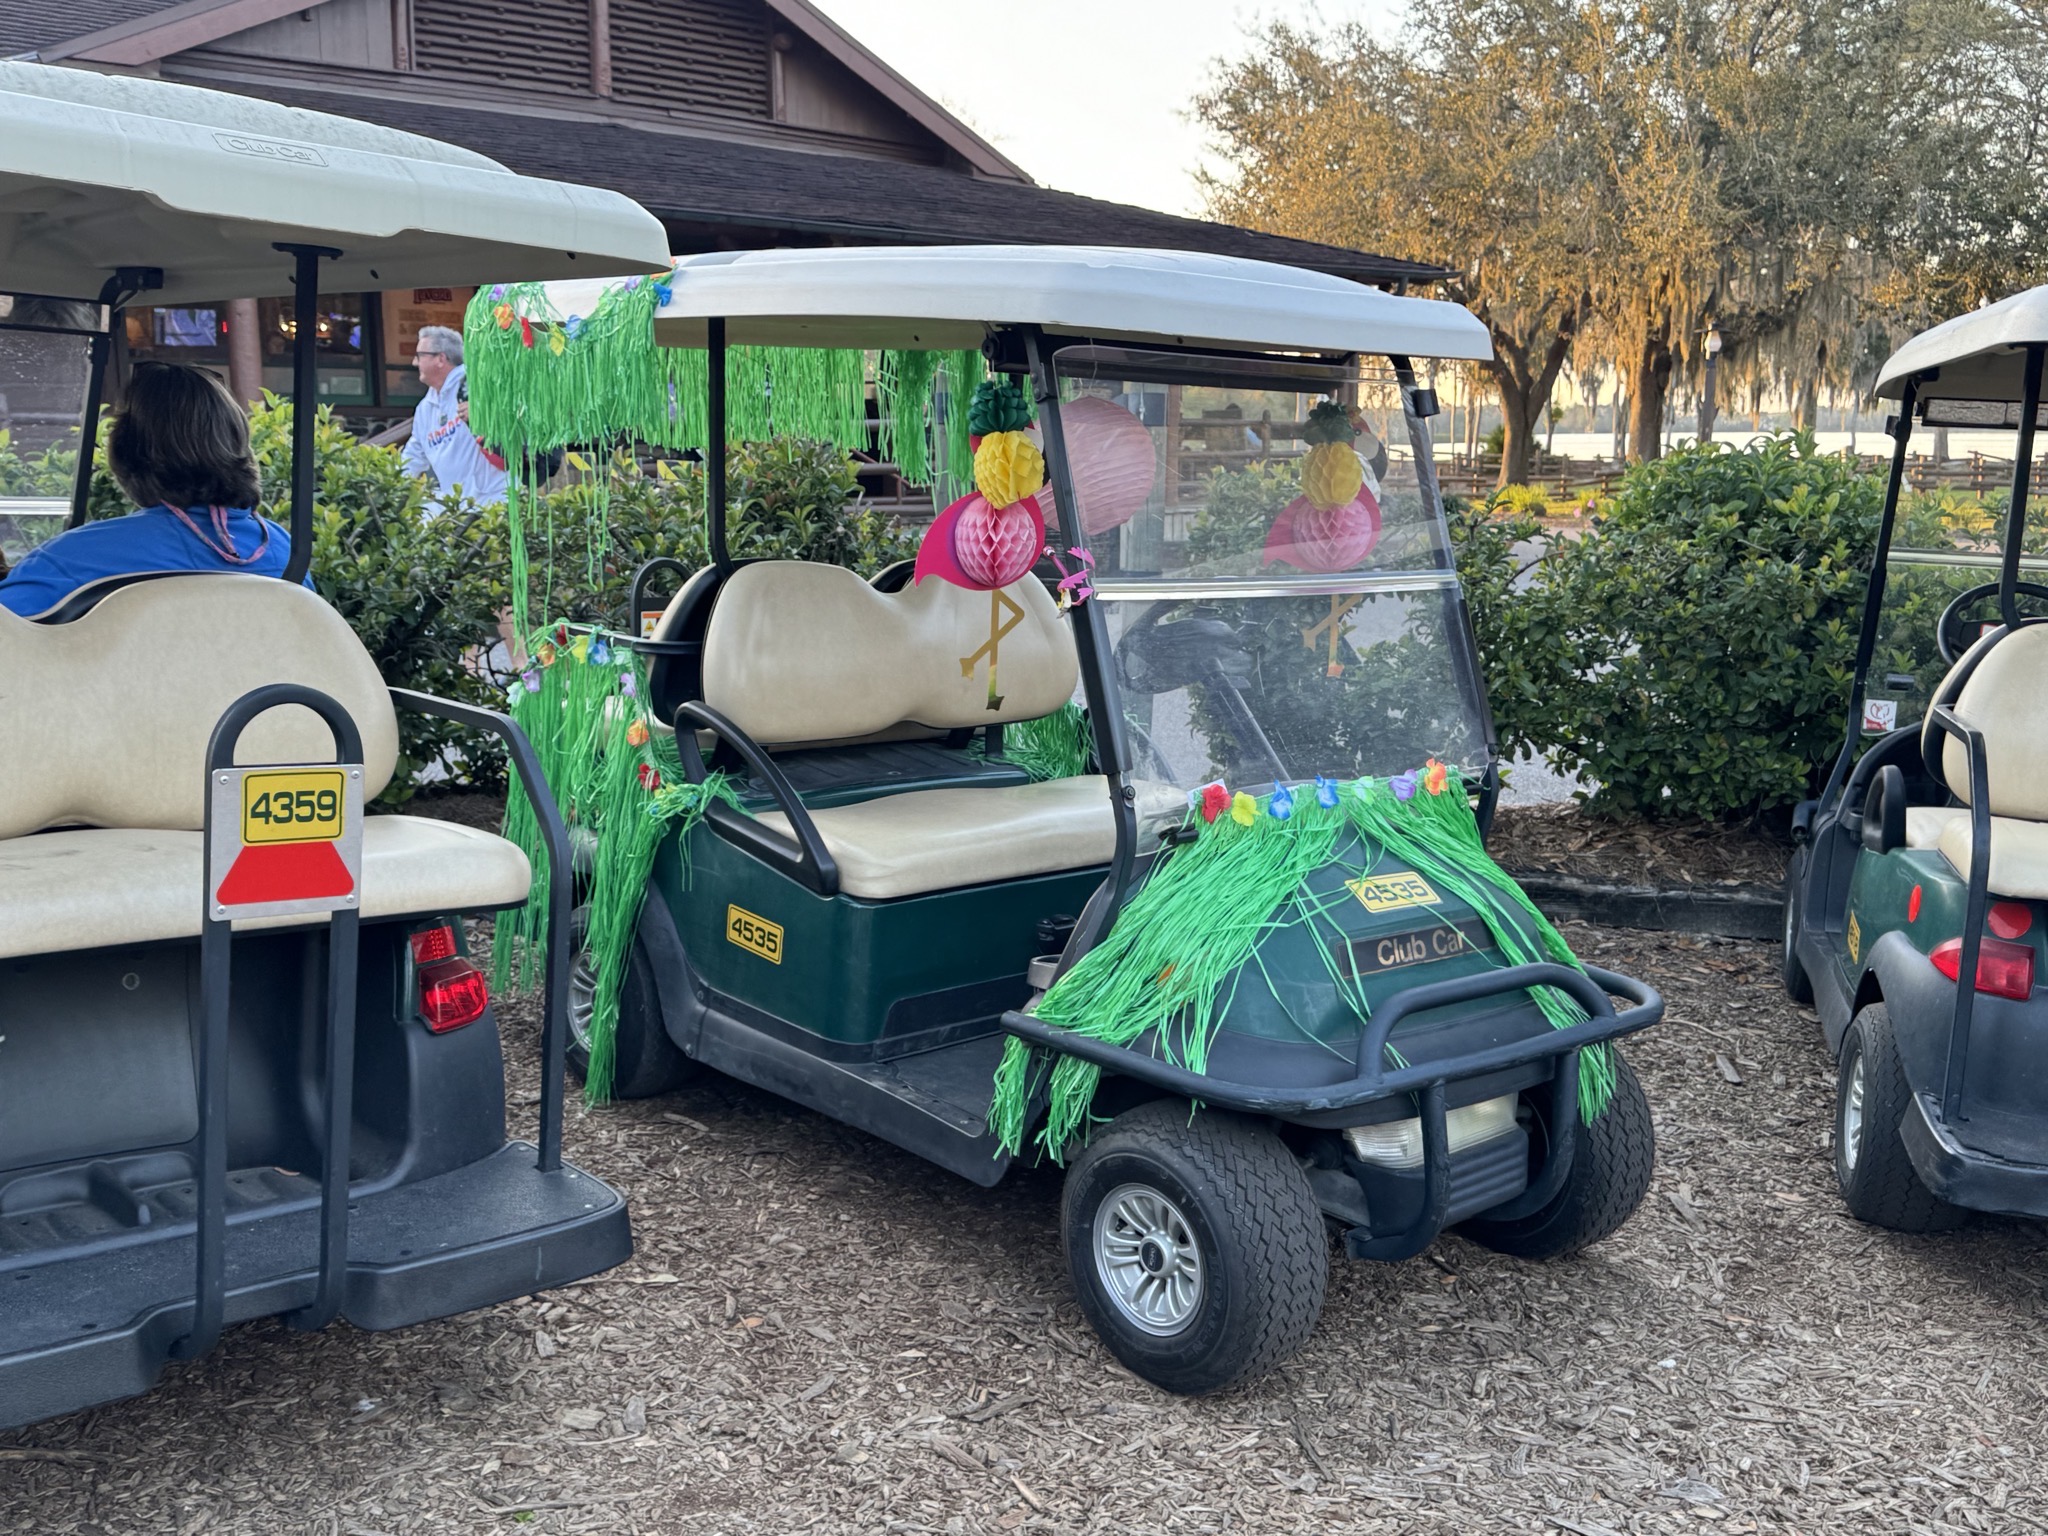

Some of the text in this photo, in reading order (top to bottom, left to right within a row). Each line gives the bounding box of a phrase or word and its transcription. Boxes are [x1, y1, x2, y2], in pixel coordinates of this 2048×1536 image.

[227, 139, 276, 155] Club
[250, 790, 337, 825] 4359
[1363, 880, 1429, 903] 4535
[731, 917, 778, 953] 4535
[1377, 929, 1465, 966] Club Car
